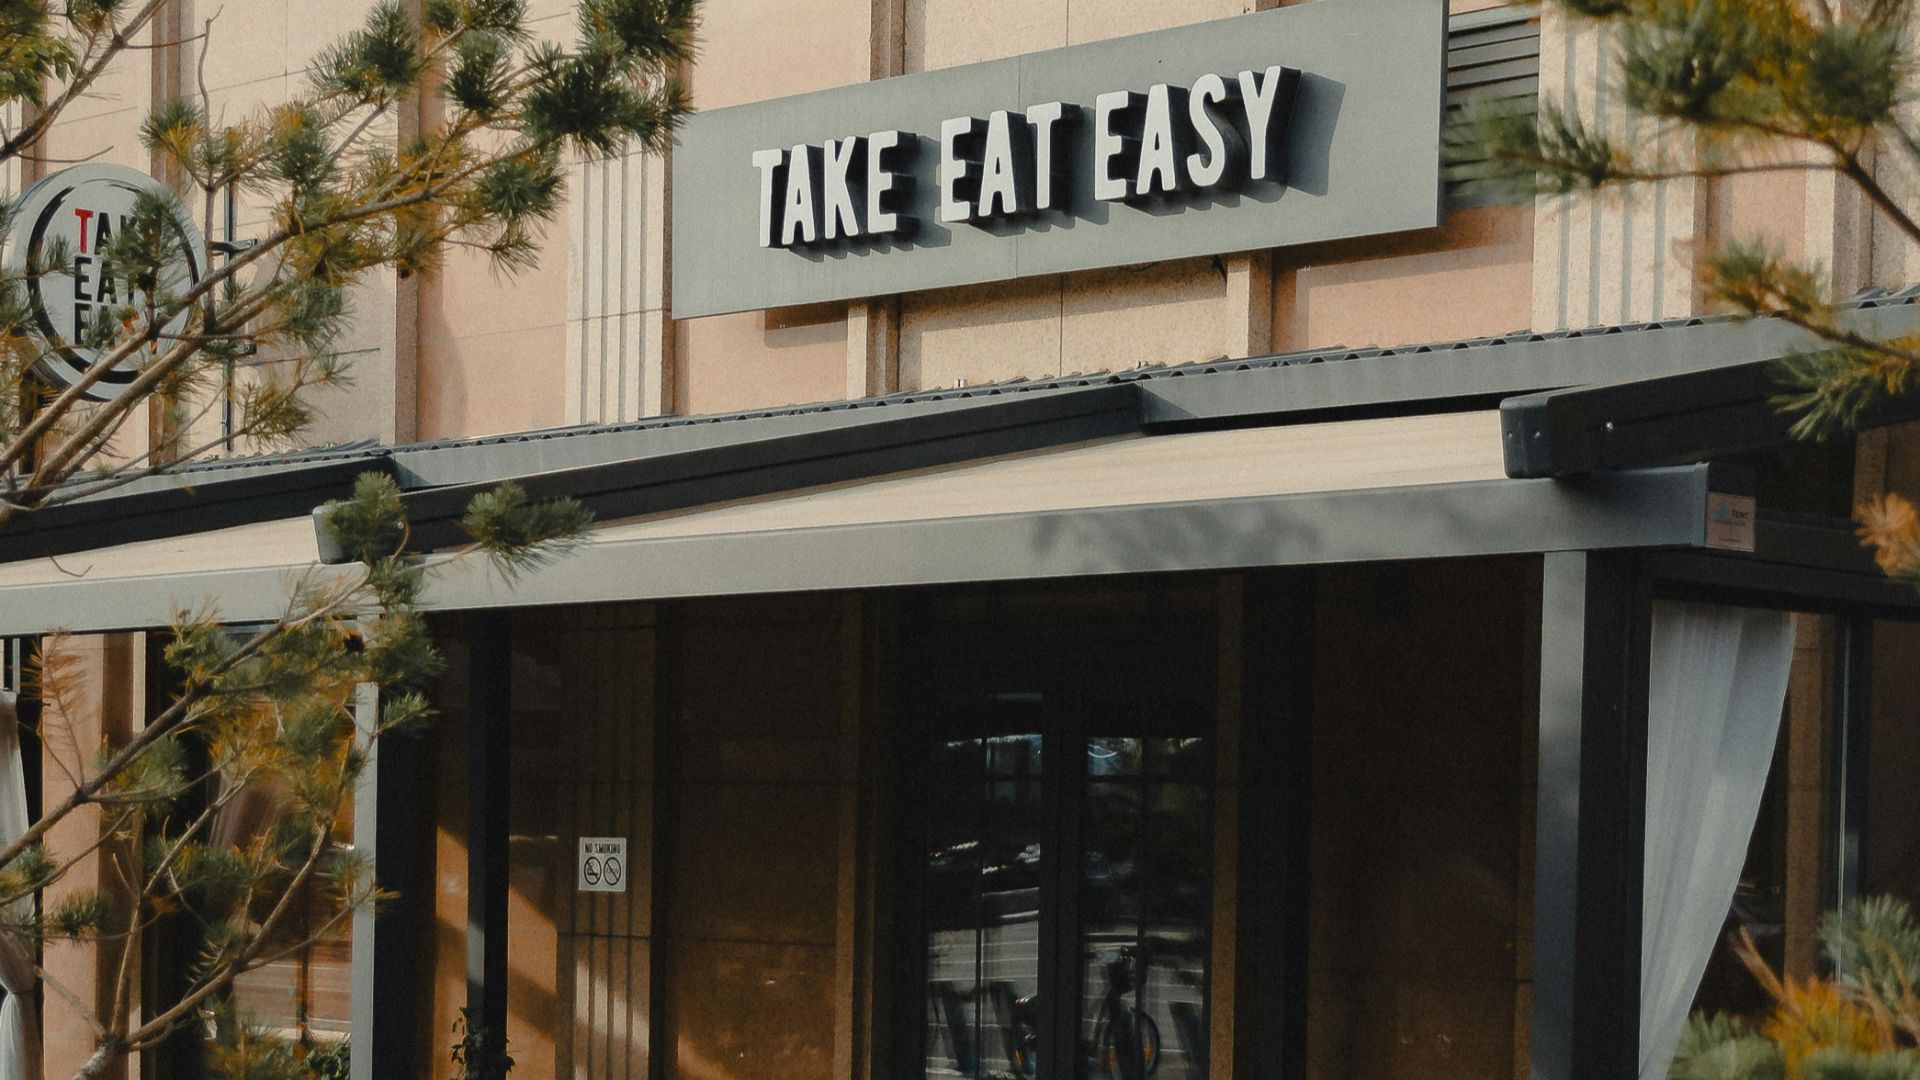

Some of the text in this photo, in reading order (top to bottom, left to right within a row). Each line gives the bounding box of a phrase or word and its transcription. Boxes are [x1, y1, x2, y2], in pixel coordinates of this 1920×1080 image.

[752, 65, 1281, 247] TAKE EAT EASY
[584, 842, 621, 854] NO SMOKING
